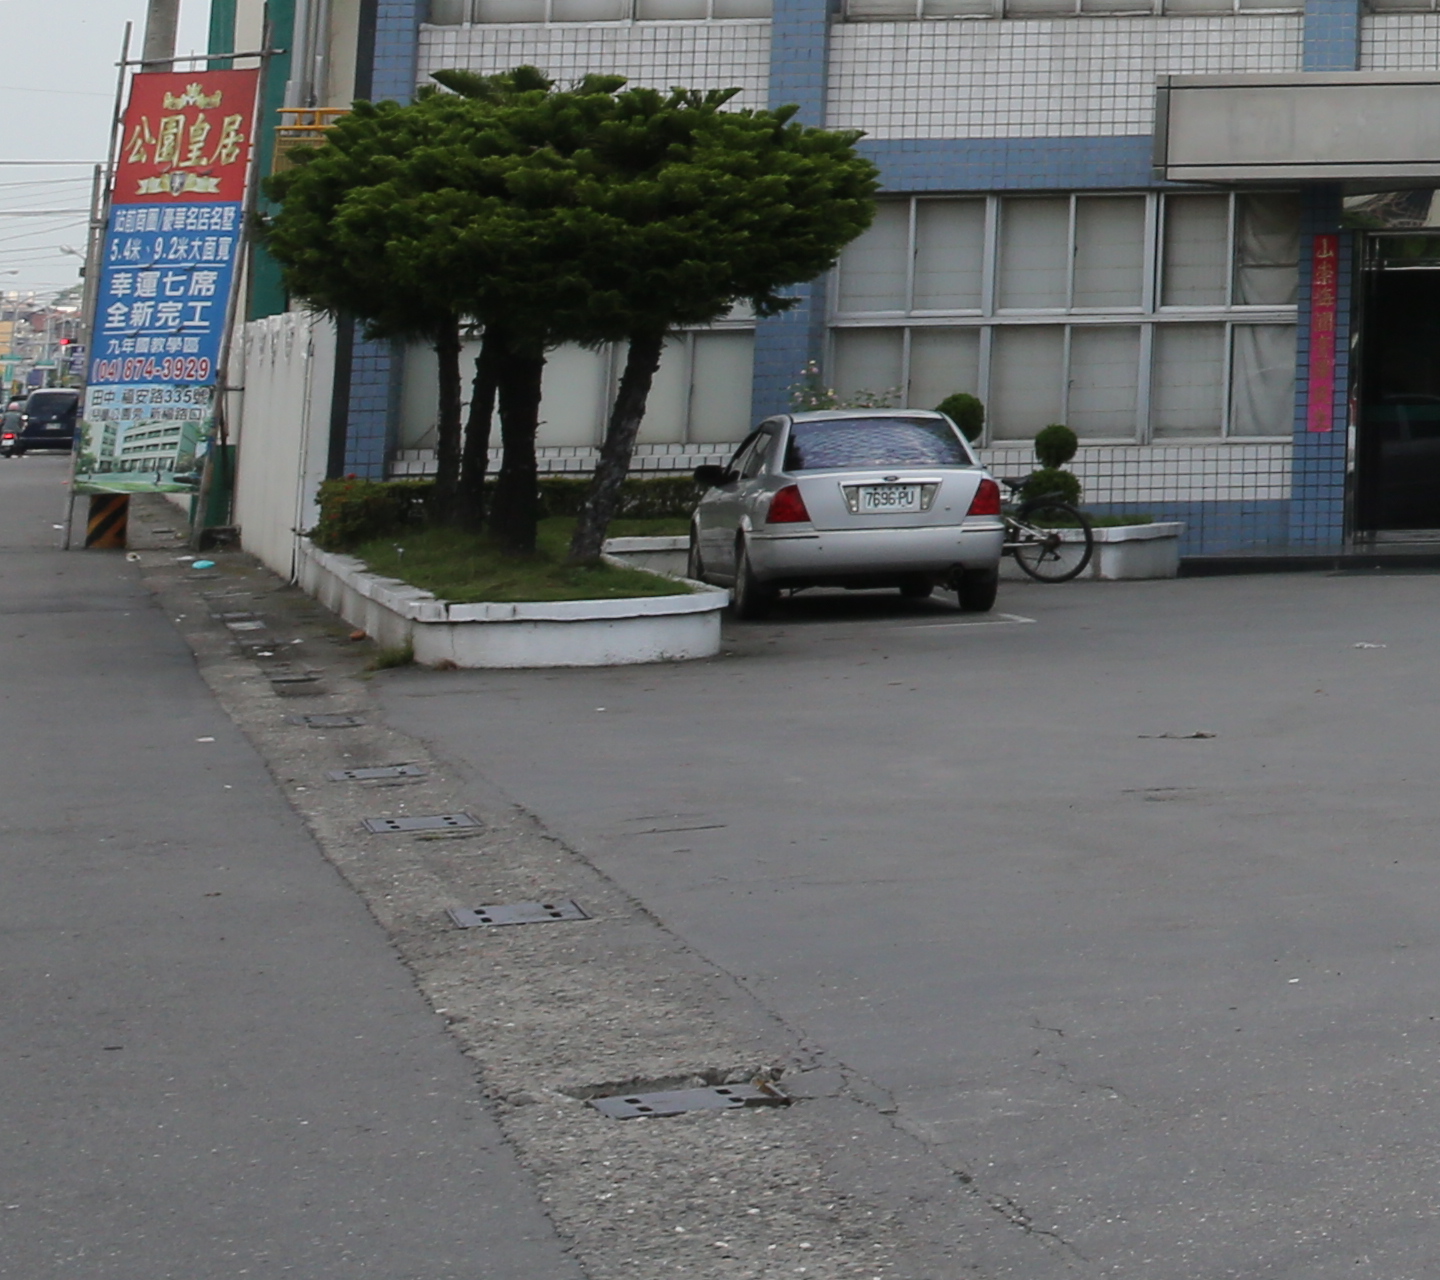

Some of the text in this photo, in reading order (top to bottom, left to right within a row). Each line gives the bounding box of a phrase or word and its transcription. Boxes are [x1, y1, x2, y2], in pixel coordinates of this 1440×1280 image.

[110, 271, 218, 297] 幸運七席
[104, 301, 212, 328] 全新完工
[106, 337, 200, 354] 九年國教學區
[92, 389, 115, 406] 田中
